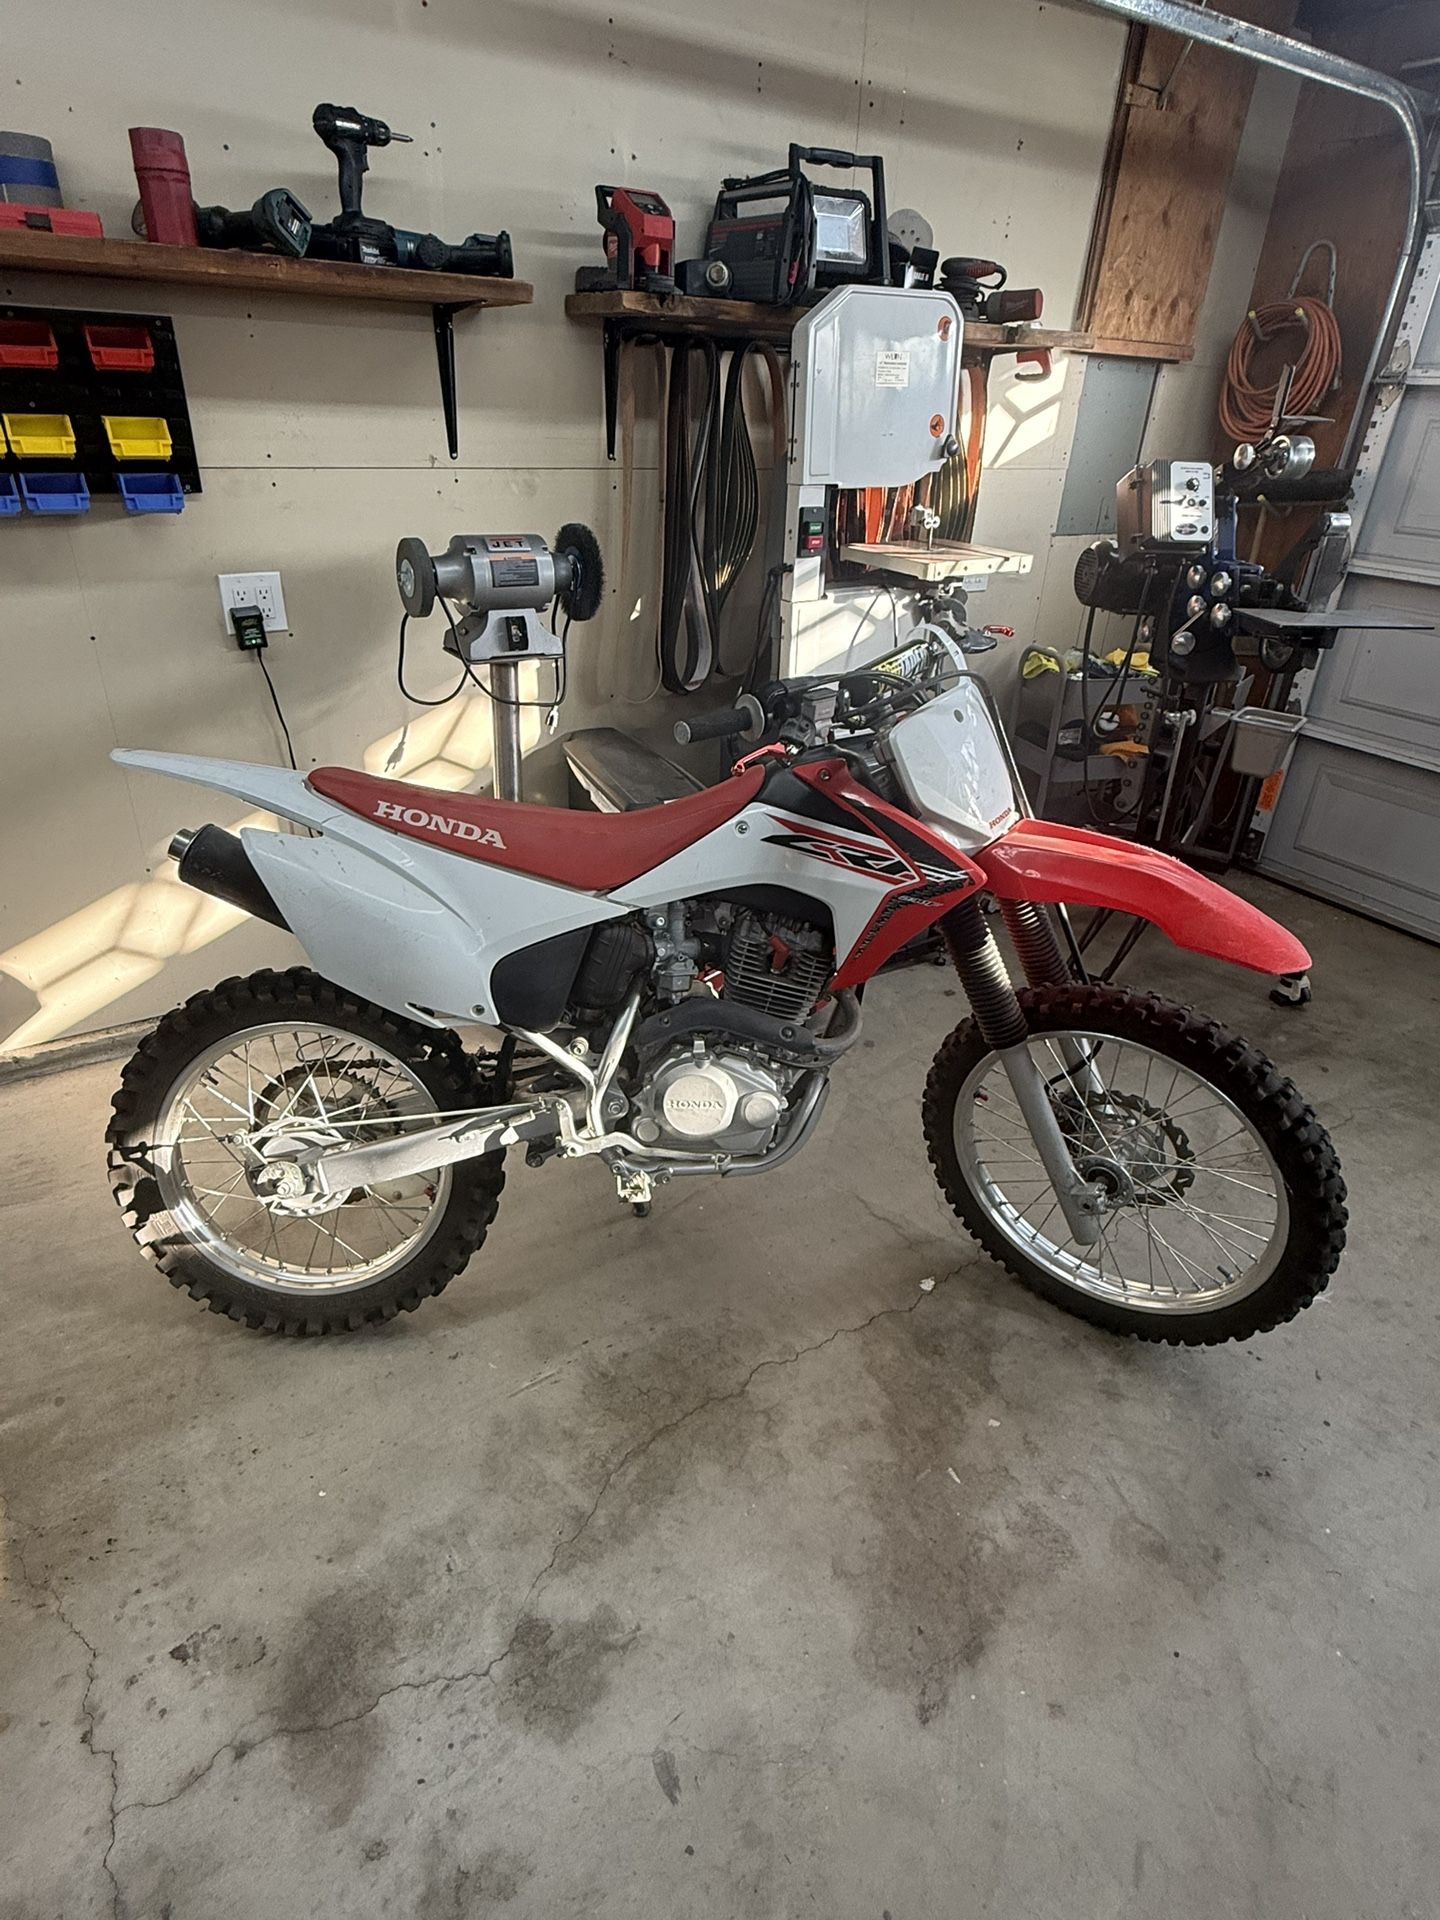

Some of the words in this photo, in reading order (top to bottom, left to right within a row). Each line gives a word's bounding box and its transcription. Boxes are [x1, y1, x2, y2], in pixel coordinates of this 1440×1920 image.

[373, 800, 507, 849] HONDA
[989, 807, 1012, 829] HONDA
[668, 1099, 723, 1110] HONDA
